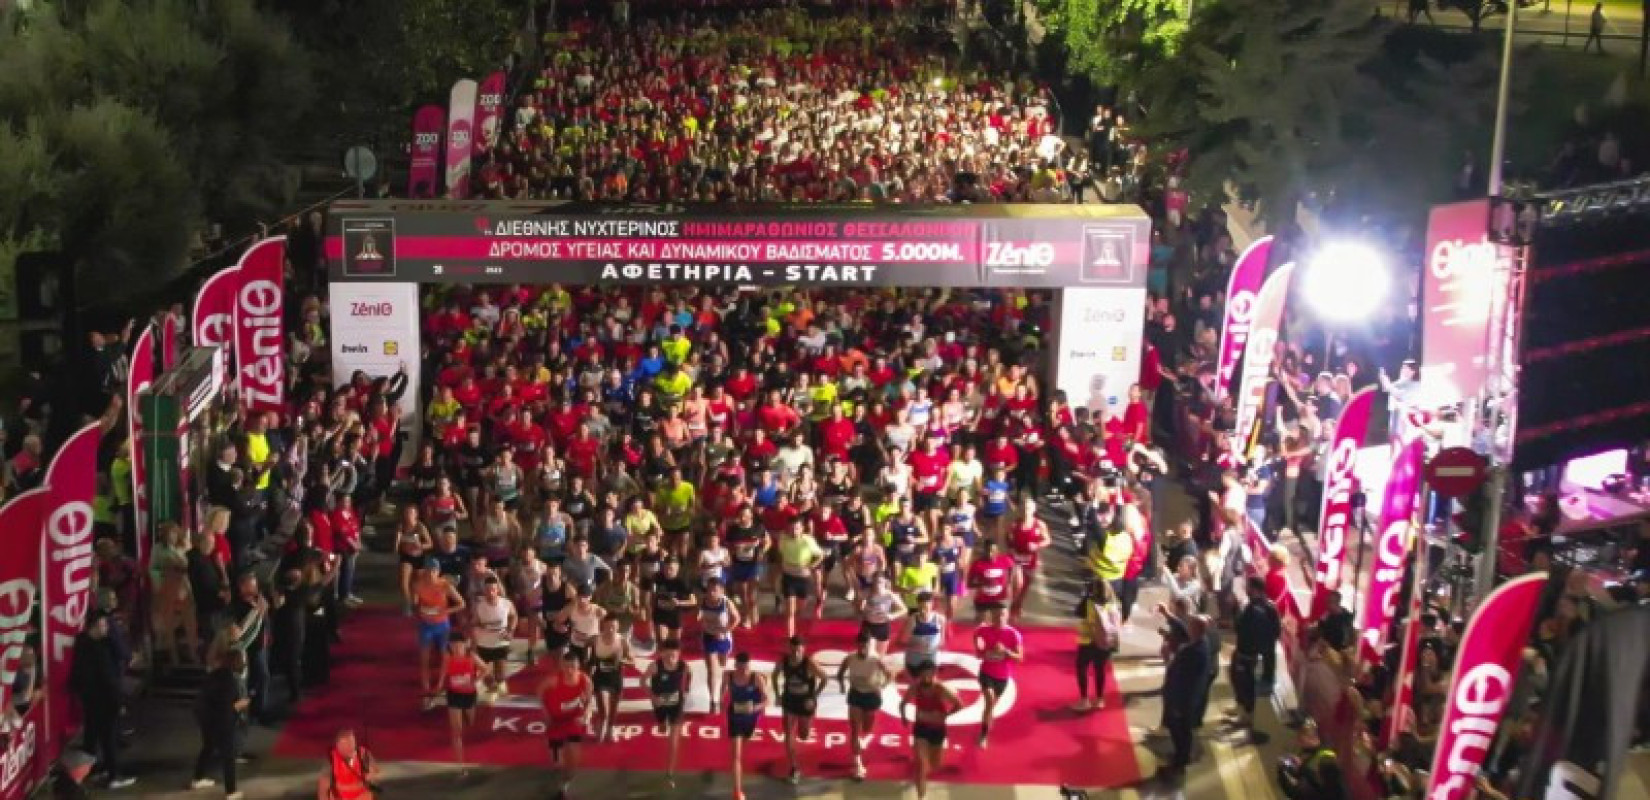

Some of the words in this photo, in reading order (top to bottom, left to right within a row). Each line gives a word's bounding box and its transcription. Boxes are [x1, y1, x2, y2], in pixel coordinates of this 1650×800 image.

[495, 220, 570, 236] ΔΙΕΘΝΗΣ
[574, 220, 680, 236] ΝΥΧΤΕΡΙΝΟΣ
[489, 241, 562, 257] ΔΡΟΜΟΣ
[566, 242, 623, 258] ΥΓΕΙΑΣ
[628, 242, 656, 259] ΚΑΙ
[661, 243, 761, 260] ΔΥΝΑΜΙΚΟΥ
[766, 244, 873, 261] ΒΑΔΙΣΜΑΤΟΣ
[601, 263, 752, 280] ΑΦΕΤΗΡΙΑ
[785, 265, 877, 281] START
